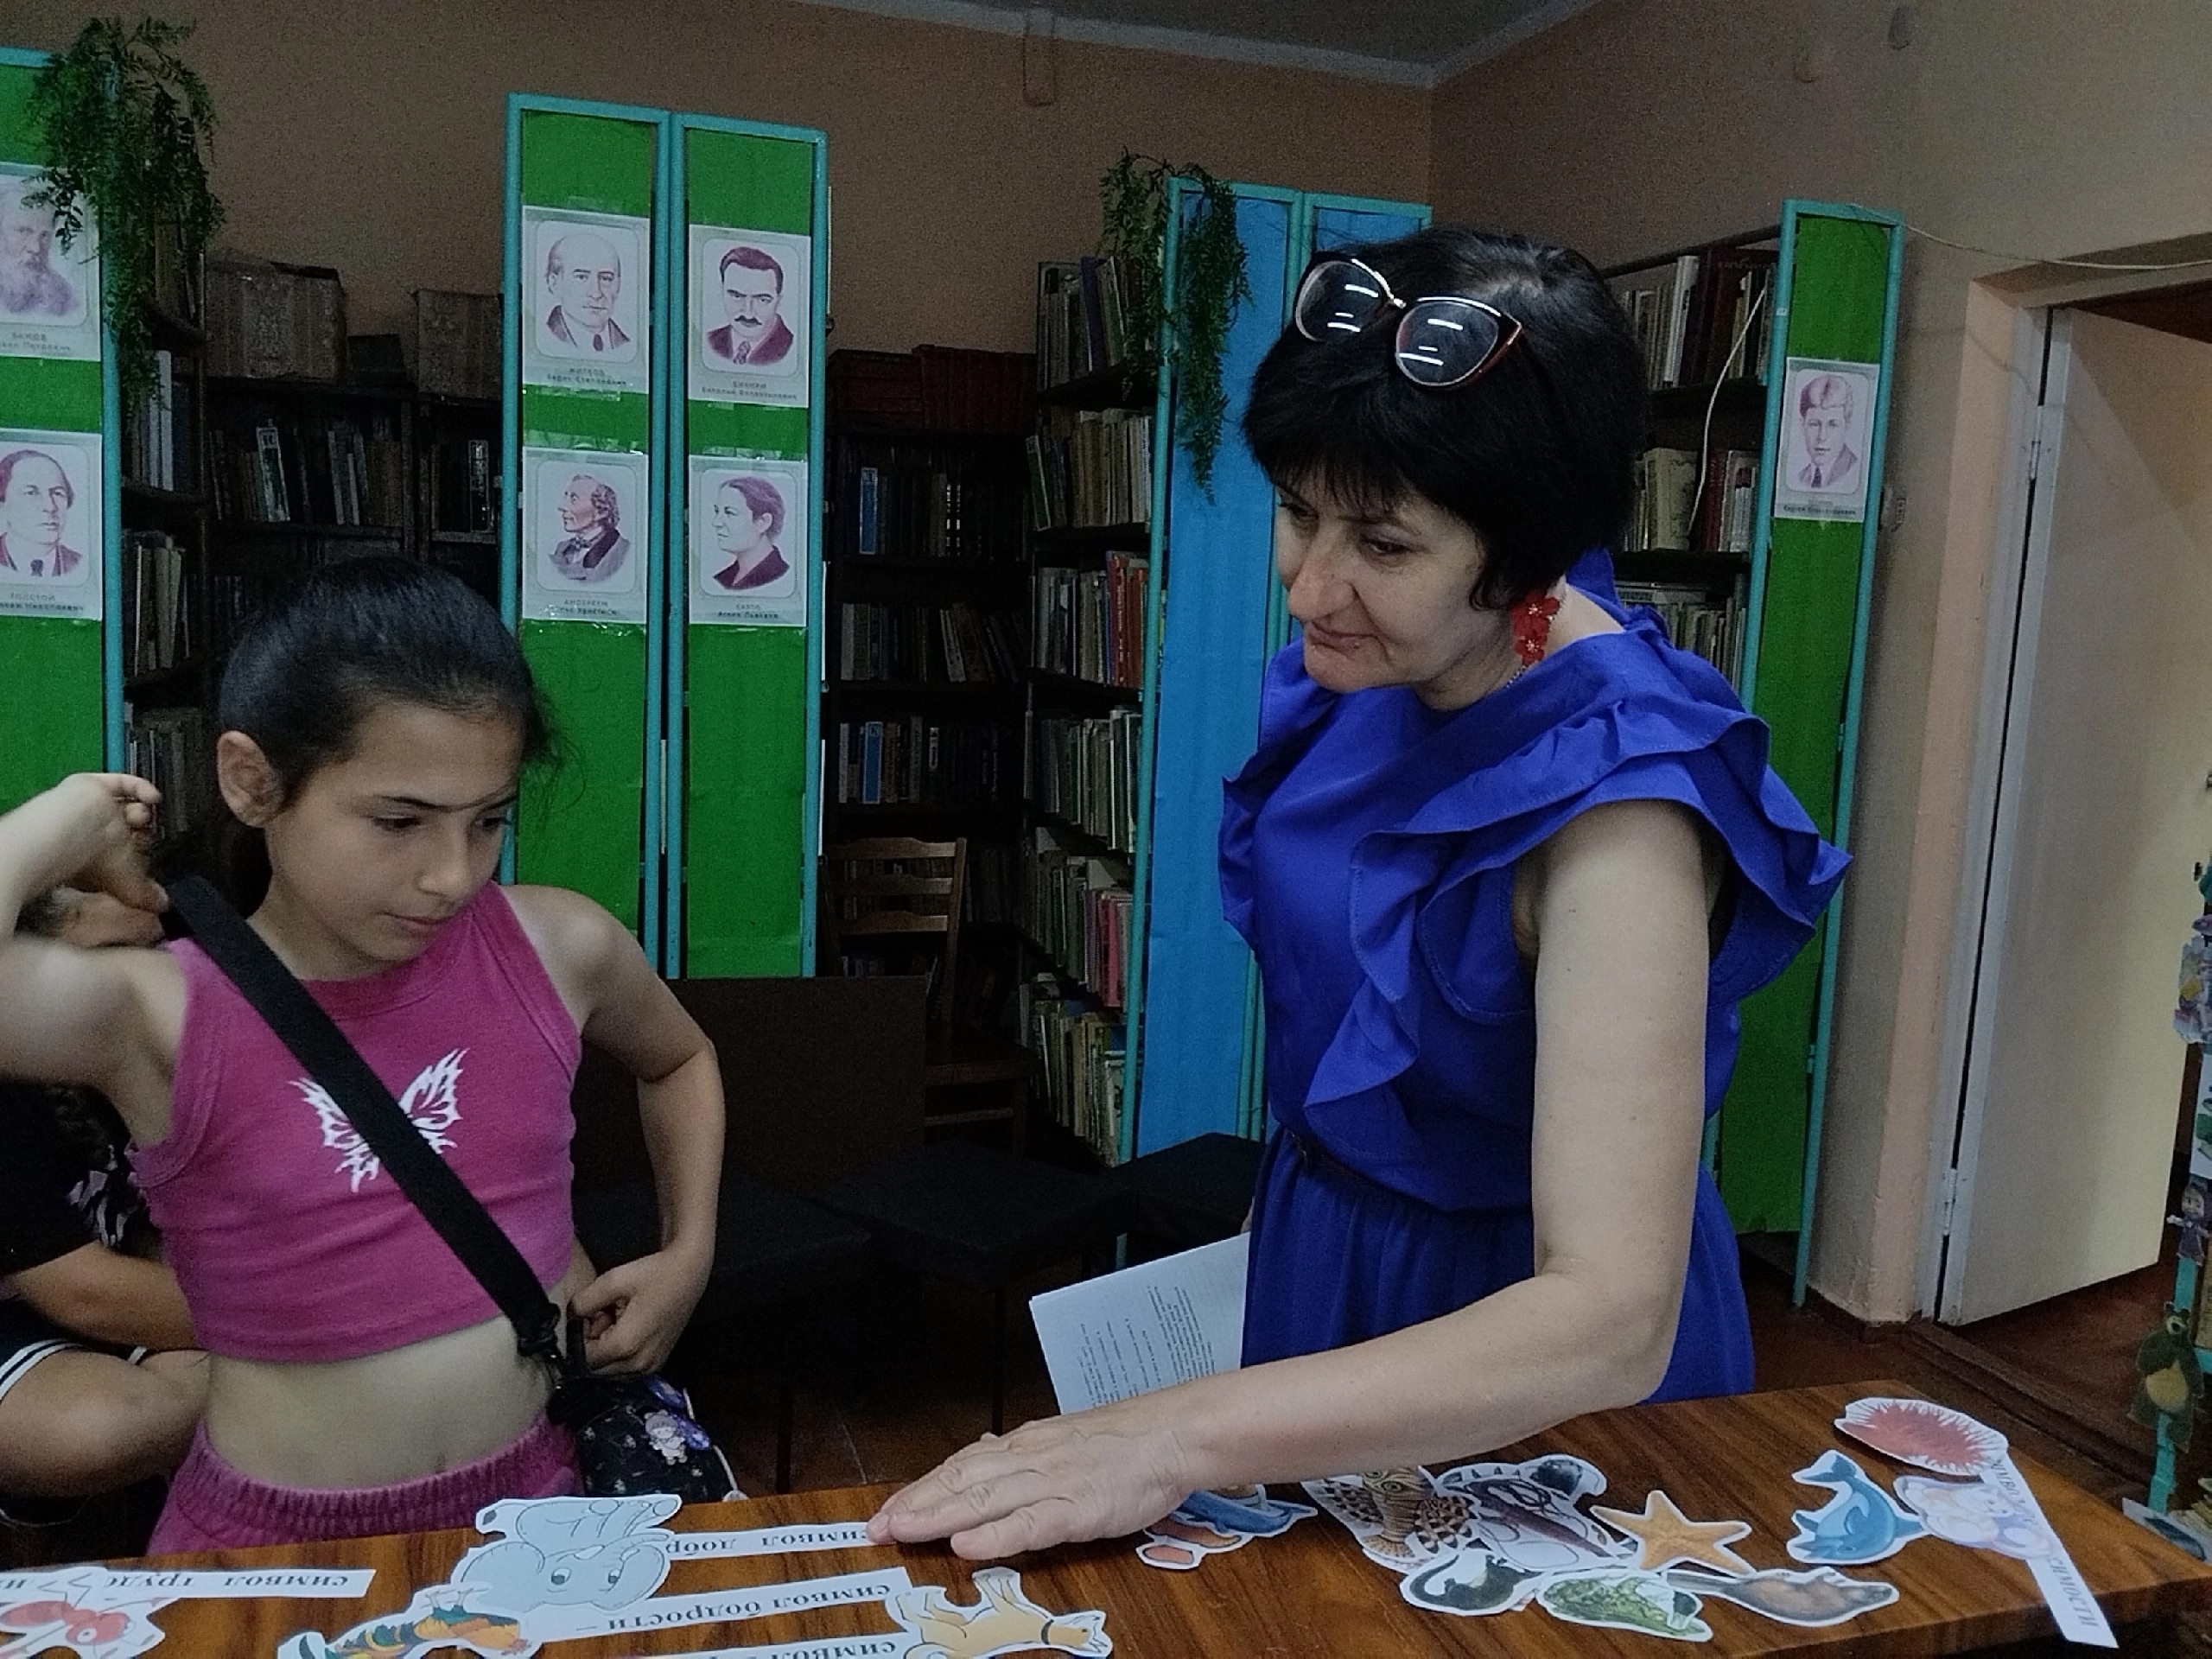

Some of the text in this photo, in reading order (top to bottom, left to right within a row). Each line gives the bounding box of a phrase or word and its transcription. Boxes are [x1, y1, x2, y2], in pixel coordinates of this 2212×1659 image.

[223, 1573, 349, 1589] символ
[772, 1584, 890, 1608] символ
[607, 1601, 761, 1630] бодрости
